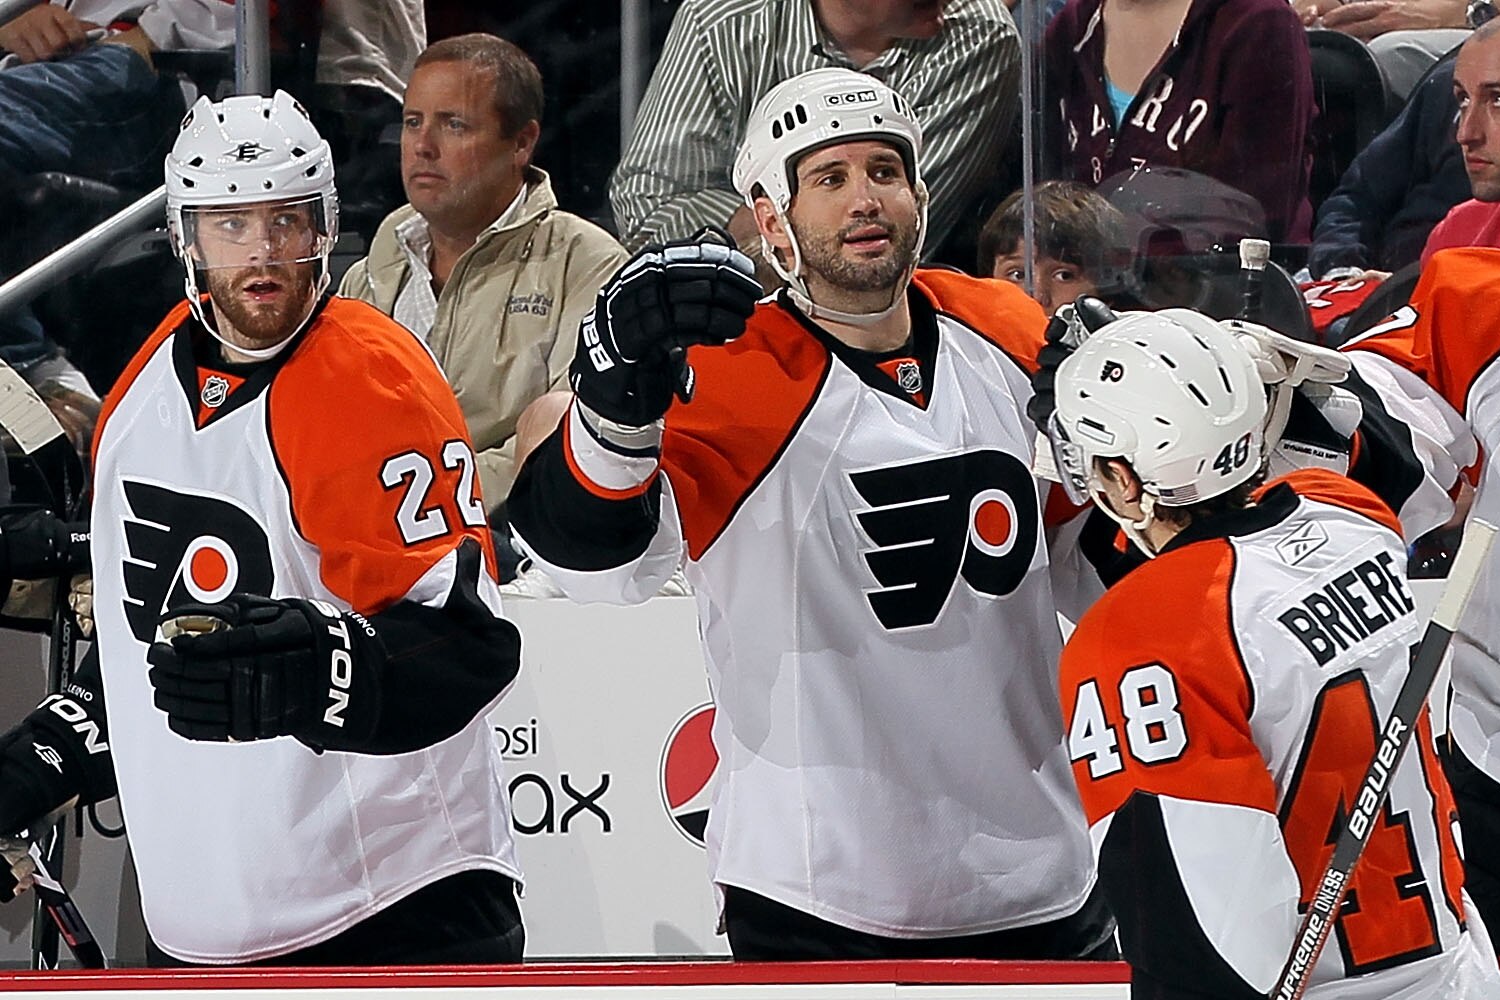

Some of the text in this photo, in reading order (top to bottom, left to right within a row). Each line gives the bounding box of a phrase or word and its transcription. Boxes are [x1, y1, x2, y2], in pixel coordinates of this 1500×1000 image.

[828, 90, 877, 105] CCM
[379, 438, 487, 548] 22
[1213, 437, 1252, 476] 48
[1277, 551, 1416, 667] BRIERE
[1068, 660, 1189, 781] 48
[1278, 640, 1467, 978] 4
[1349, 715, 1407, 841] BAUER
[1314, 868, 1345, 913] ONE95
